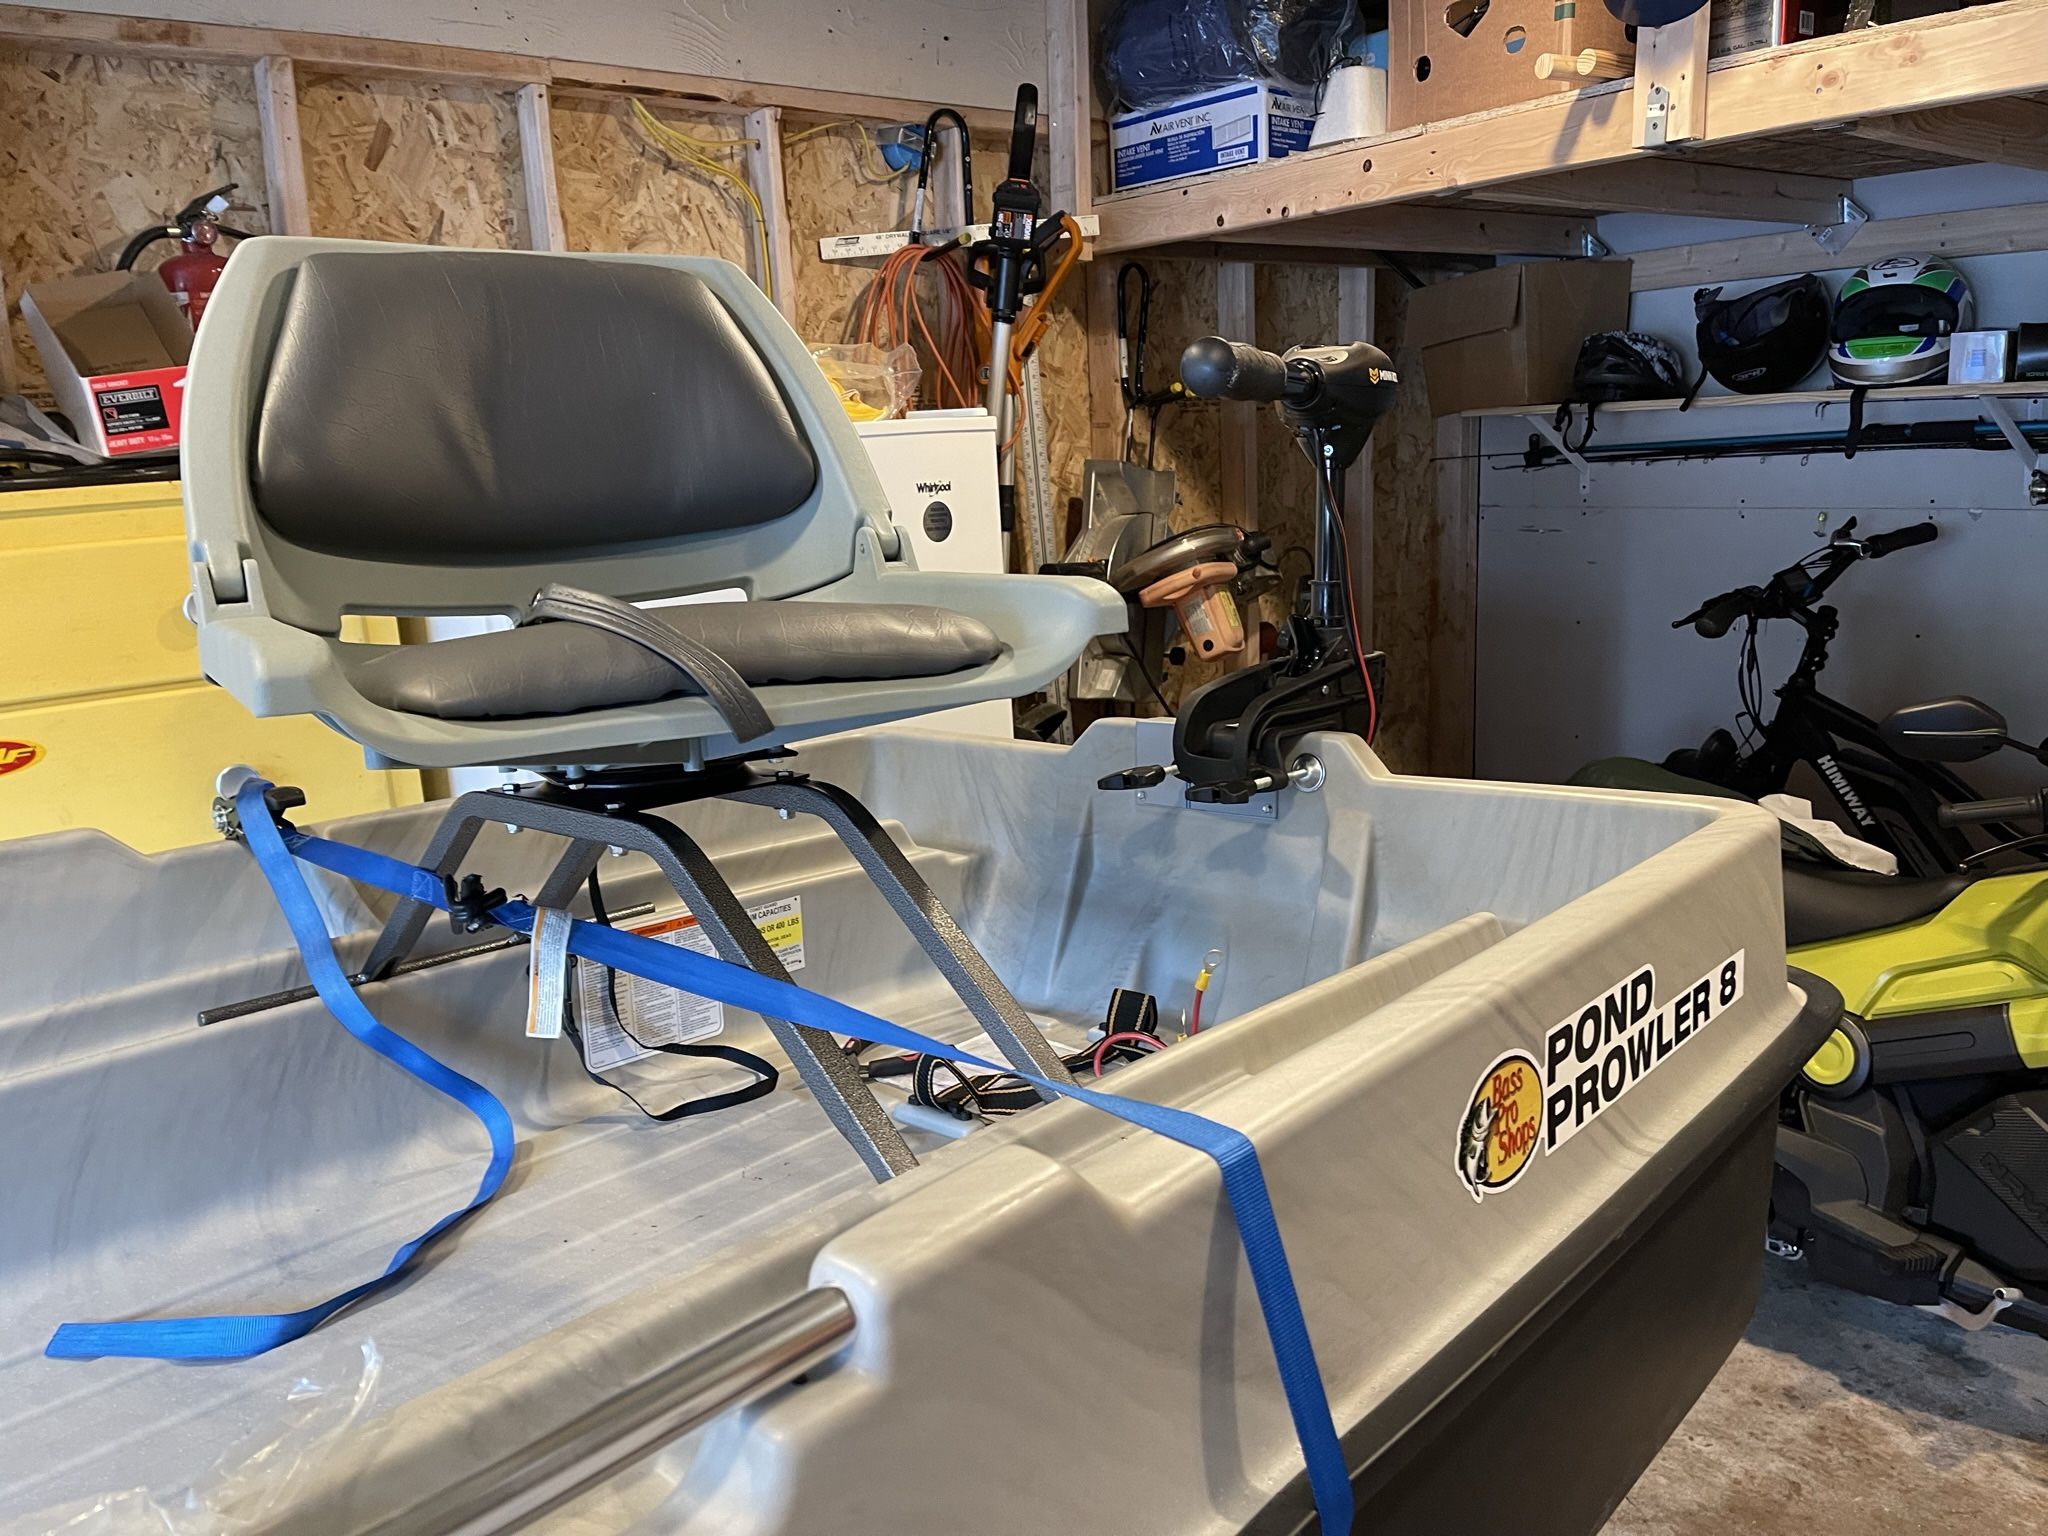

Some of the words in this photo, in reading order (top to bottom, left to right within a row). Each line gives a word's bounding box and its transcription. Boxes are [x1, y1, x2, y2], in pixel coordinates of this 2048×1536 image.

[1162, 121, 1175, 133] AIR
[1175, 116, 1194, 129] VENT
[1271, 116, 1290, 127] INTAKE
[1117, 146, 1136, 159] INTAKE
[1136, 143, 1151, 154] VENT
[102, 390, 154, 404] EVERBILT
[916, 481, 951, 495] Whirlpool
[1817, 754, 1876, 826] HIMIWAY
[758, 904, 792, 919] CAPACITIES
[767, 924, 775, 932] OR
[787, 917, 800, 927] LBS
[1547, 969, 1653, 1088] POND
[1547, 978, 1711, 1151] PROWLER
[1719, 960, 1736, 1007] 8
[1491, 1067, 1523, 1108] Bass
[1498, 1115, 1536, 1166] Shops
